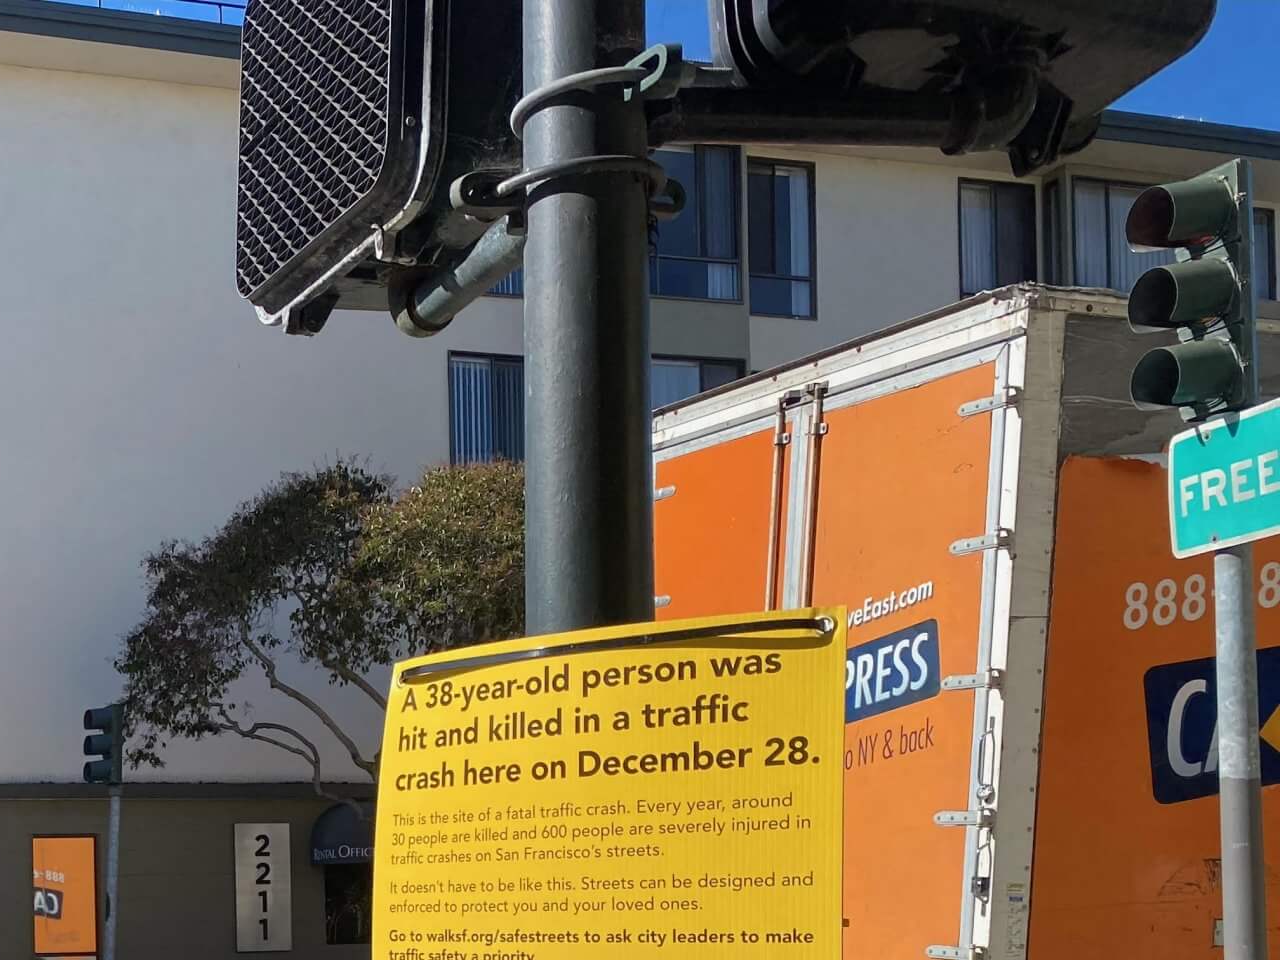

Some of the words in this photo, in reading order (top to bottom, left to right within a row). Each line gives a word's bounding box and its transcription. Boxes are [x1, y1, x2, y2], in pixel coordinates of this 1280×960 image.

[1180, 449, 1280, 518] FREE
[402, 688, 418, 712] A
[425, 664, 570, 711] 38-year-old
[582, 659, 696, 697] person
[710, 651, 782, 677] was
[399, 726, 427, 752] hit
[435, 716, 478, 747] and
[489, 707, 561, 741] killed
[575, 707, 599, 733] in
[612, 711, 629, 730] a
[641, 695, 748, 728] traffic
[858, 733, 878, 766] NY
[883, 729, 893, 759] &
[900, 717, 934, 755] back
[396, 761, 454, 791] crash
[464, 759, 521, 785] here
[531, 760, 565, 780] on
[578, 741, 752, 777] December
[764, 736, 819, 766] 28.
[393, 814, 414, 826] This
[418, 813, 426, 824] is
[430, 811, 448, 824] the
[452, 809, 473, 823] site
[478, 807, 490, 821] of
[495, 811, 502, 820] a
[506, 805, 535, 819] fatal
[540, 802, 581, 818] traffic
[586, 800, 630, 815] crash.
[637, 799, 681, 816] Every
[686, 800, 725, 815] year,
[731, 792, 792, 809] around
[392, 833, 405, 845] 30
[408, 830, 447, 848] people
[452, 833, 470, 842] are
[475, 827, 507, 841] killed
[512, 825, 536, 840] and
[541, 824, 567, 839] 600
[572, 823, 623, 841] people
[629, 824, 653, 835] are
[659, 817, 725, 836] severely
[732, 814, 789, 835] injured
[796, 815, 810, 829] in
[338, 844, 373, 858] OFFIC
[391, 850, 423, 864] traffic
[426, 849, 471, 863] crashes
[475, 852, 491, 861] on
[496, 848, 519, 861] San
[524, 844, 601, 859] Francisco's
[606, 844, 664, 857] streets.
[390, 882, 396, 893] It
[401, 880, 443, 894] doesn't
[448, 880, 476, 892] have
[480, 881, 493, 892] to
[498, 878, 514, 891] be
[519, 877, 542, 891] like
[546, 876, 575, 891] this.
[581, 876, 634, 890] Streets
[639, 879, 665, 889] can
[672, 873, 692, 888] be
[697, 872, 775, 891] designed
[781, 871, 813, 886] and
[389, 899, 440, 912] enforced
[444, 902, 457, 912] to
[461, 901, 508, 916] protect
[513, 902, 537, 915] you
[542, 897, 568, 912] and
[573, 901, 605, 915] your
[611, 895, 654, 911] loved
[660, 898, 702, 910] ones.
[389, 930, 406, 941] Go
[408, 931, 422, 943] to
[426, 928, 579, 949] walksf.org/safestreets
[584, 931, 600, 942] to
[606, 929, 631, 943] ask
[638, 929, 666, 947] city
[673, 928, 734, 943] leaders
[740, 930, 759, 943] to
[766, 928, 813, 943] make
[389, 948, 424, 960] traffic
